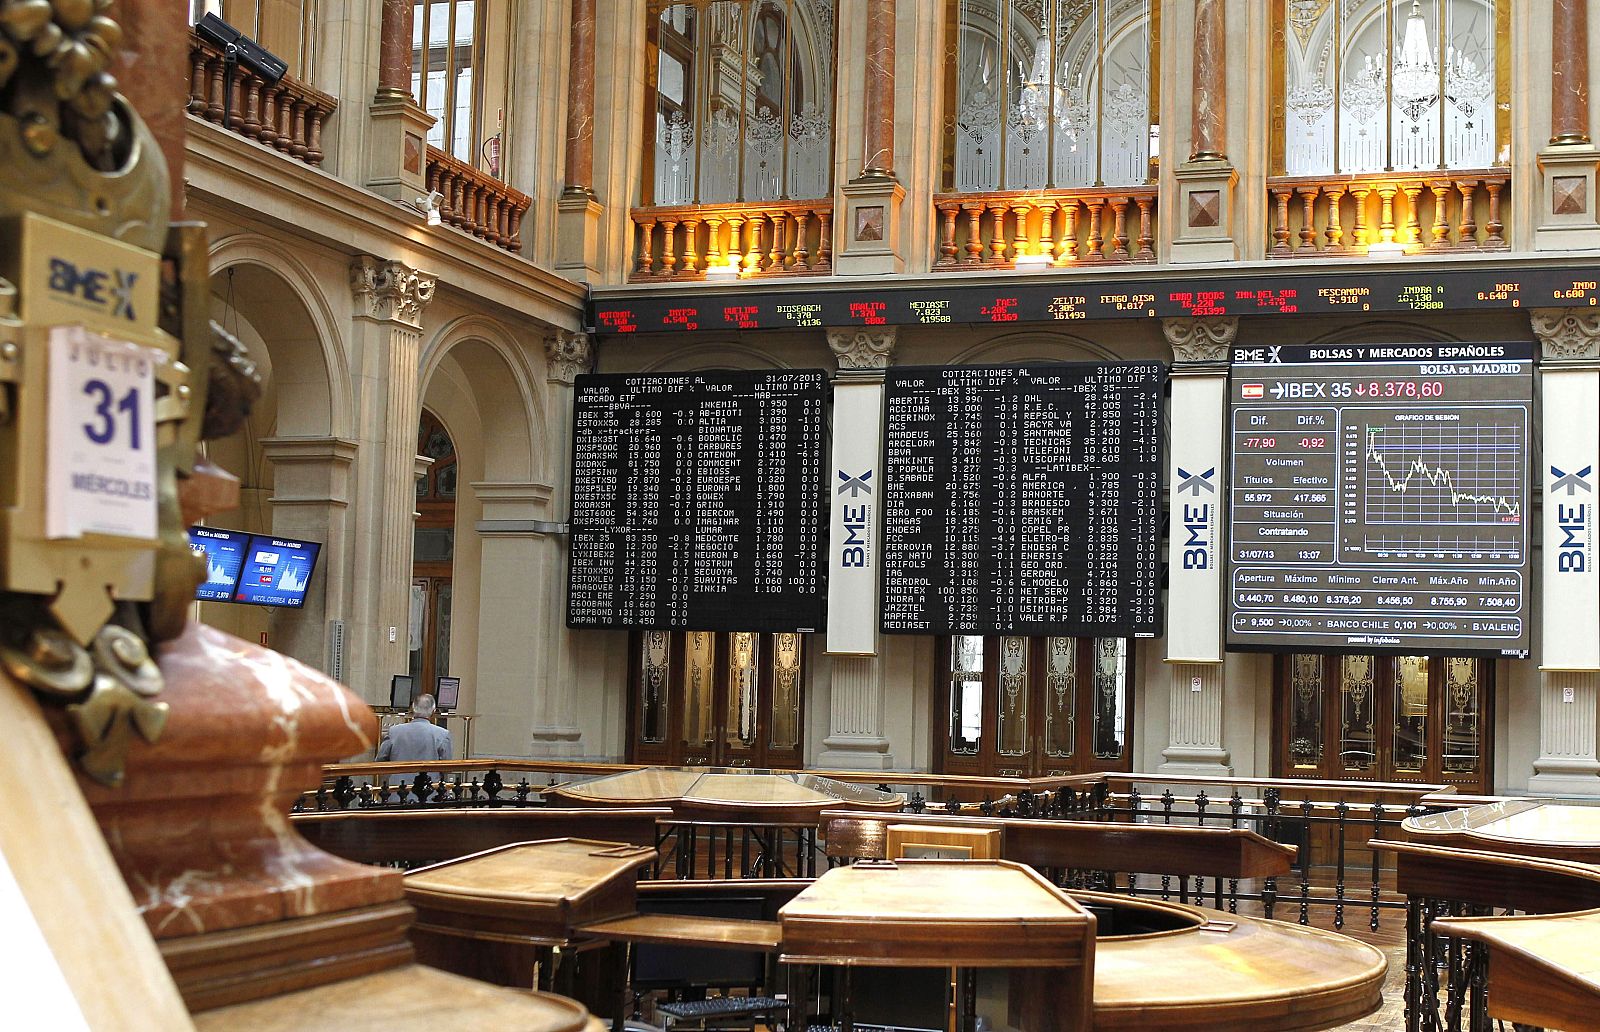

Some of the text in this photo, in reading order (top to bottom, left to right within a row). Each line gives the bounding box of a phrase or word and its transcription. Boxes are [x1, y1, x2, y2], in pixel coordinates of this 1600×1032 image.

[1318, 288, 1370, 297] PESCANOVA
[1494, 284, 1519, 293] DOGI
[1279, 290, 1296, 299] SUR
[1478, 292, 1507, 300] 0.640
[996, 299, 1017, 307] FAES
[1052, 297, 1085, 306] ZELTIA
[1101, 295, 1154, 305] FERGO AISA
[1328, 295, 1358, 304] 5.910
[910, 301, 950, 310] MEDIASET
[1052, 311, 1085, 319] 161493
[1191, 306, 1225, 315] 251399
[797, 318, 821, 326] 14136
[1310, 345, 1504, 358] BOLSAS Y MERCADOS ESPAÑOLES
[1097, 366, 1157, 374] 31/07/2013
[1419, 363, 1457, 374] BOLSA
[1472, 364, 1521, 375] MADRID
[766, 374, 821, 382] 31/07/2013
[943, 370, 1014, 379] COTIZACIONES
[626, 377, 689, 385] COTIZACIONES
[1284, 381, 1443, 400] IBEX 35 8.378,60
[84, 379, 141, 449] 31
[1251, 416, 1324, 425] Dif. Dif.%
[1244, 438, 1324, 448] -77,90 -0,92
[1294, 494, 1326, 502] 417.565
[1264, 510, 1303, 518] Situación
[1298, 551, 1320, 559] 13:07
[1238, 575, 1274, 583] Apertura
[1430, 576, 1468, 584] Máx.Año
[1239, 594, 1515, 606] 8.440,70 8.480,10 8.376,20 8.456,50 8.755,90 7.508,40
[1251, 618, 1273, 626] 9,500
[1395, 621, 1416, 629] 0,101
[1473, 623, 1521, 631] B.VALENC
